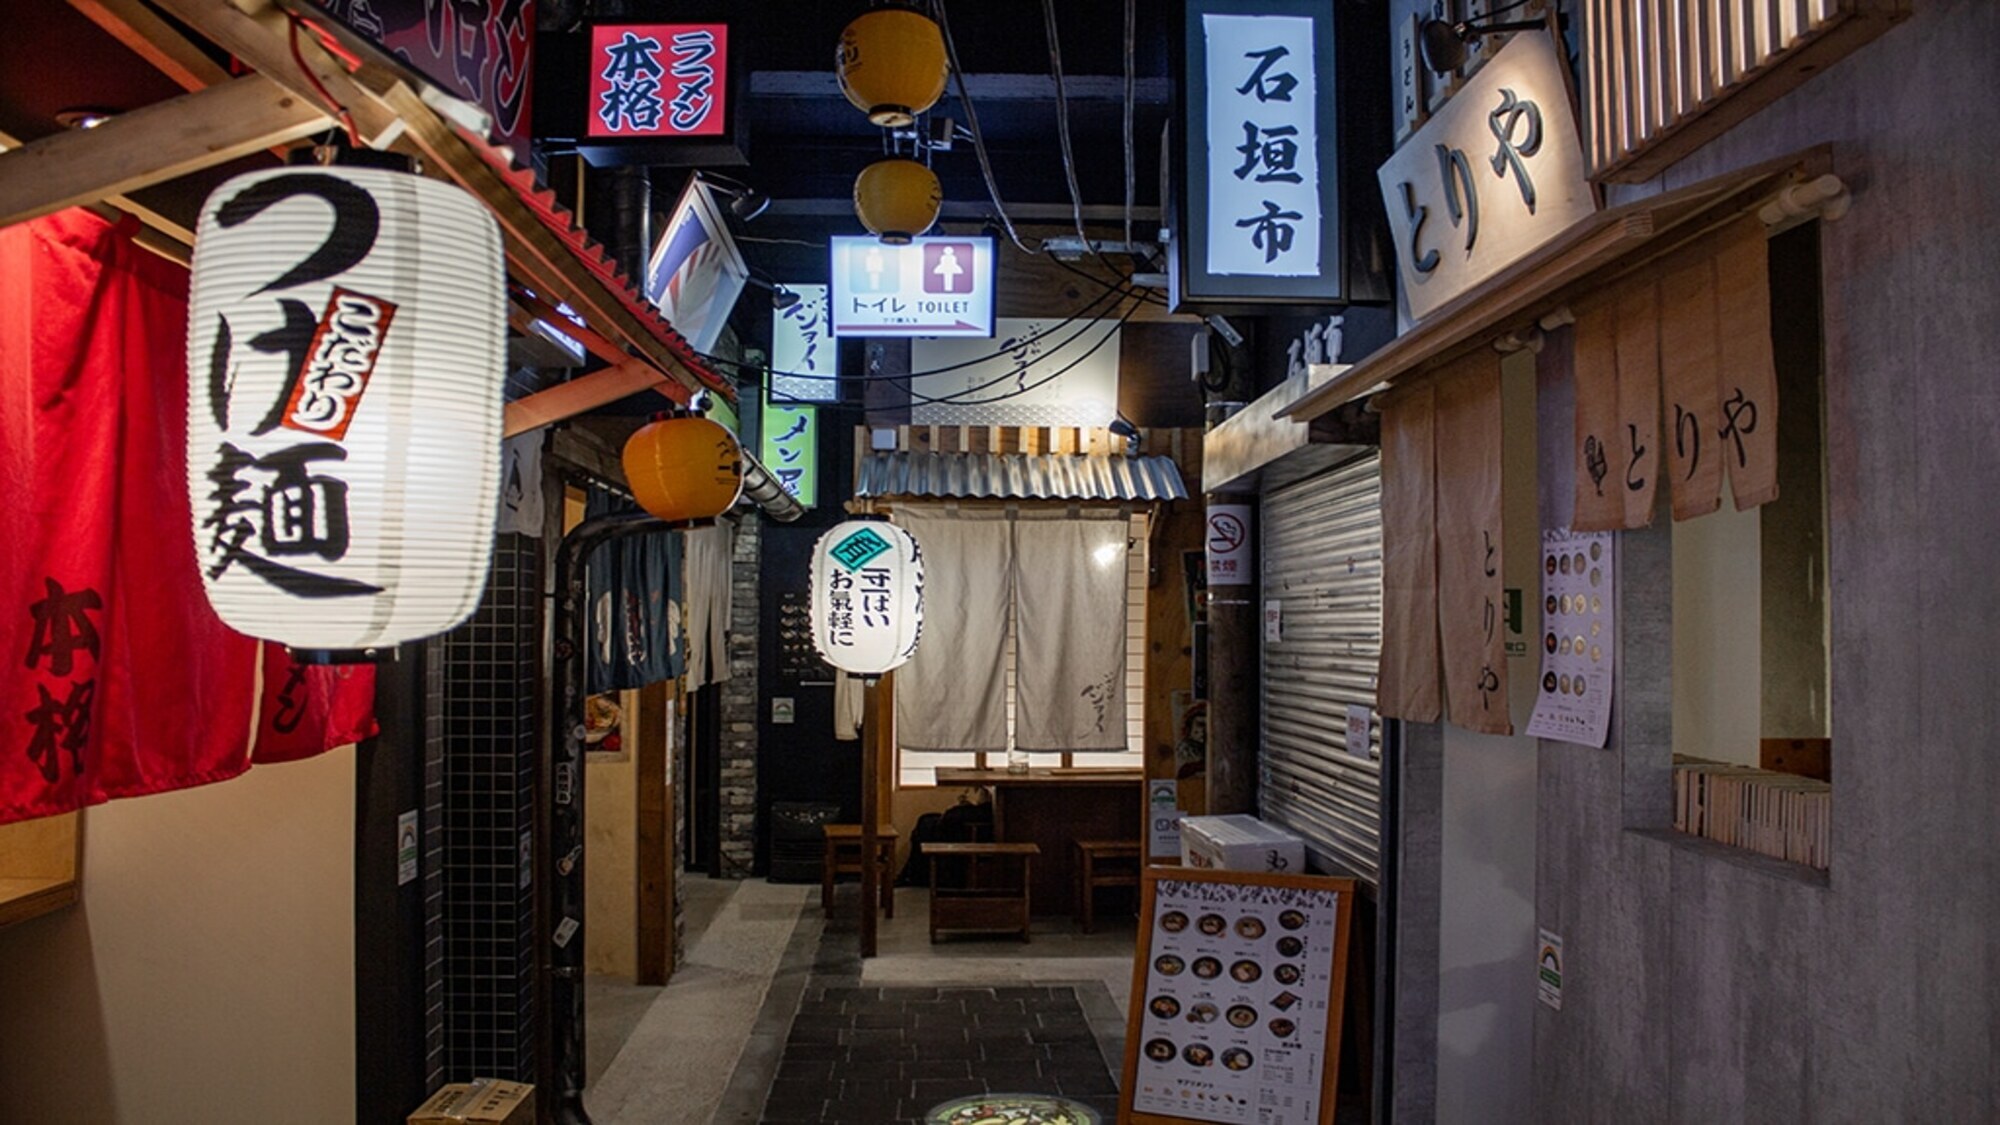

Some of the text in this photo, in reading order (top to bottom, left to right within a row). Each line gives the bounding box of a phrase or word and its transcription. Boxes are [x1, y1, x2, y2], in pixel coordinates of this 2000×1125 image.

[599, 32, 664, 131] 本格
[670, 31, 715, 131] ラーメン
[1235, 45, 1304, 264] 石垣市
[1398, 88, 1543, 272] とりや
[290, 293, 384, 433] こだわり
[853, 297, 906, 314] トイレ
[917, 301, 969, 314] TOILET
[202, 172, 388, 599] つけ麺
[1626, 387, 1757, 490] とりや
[25, 577, 102, 783] 本格
[1478, 531, 1499, 711] とりや
